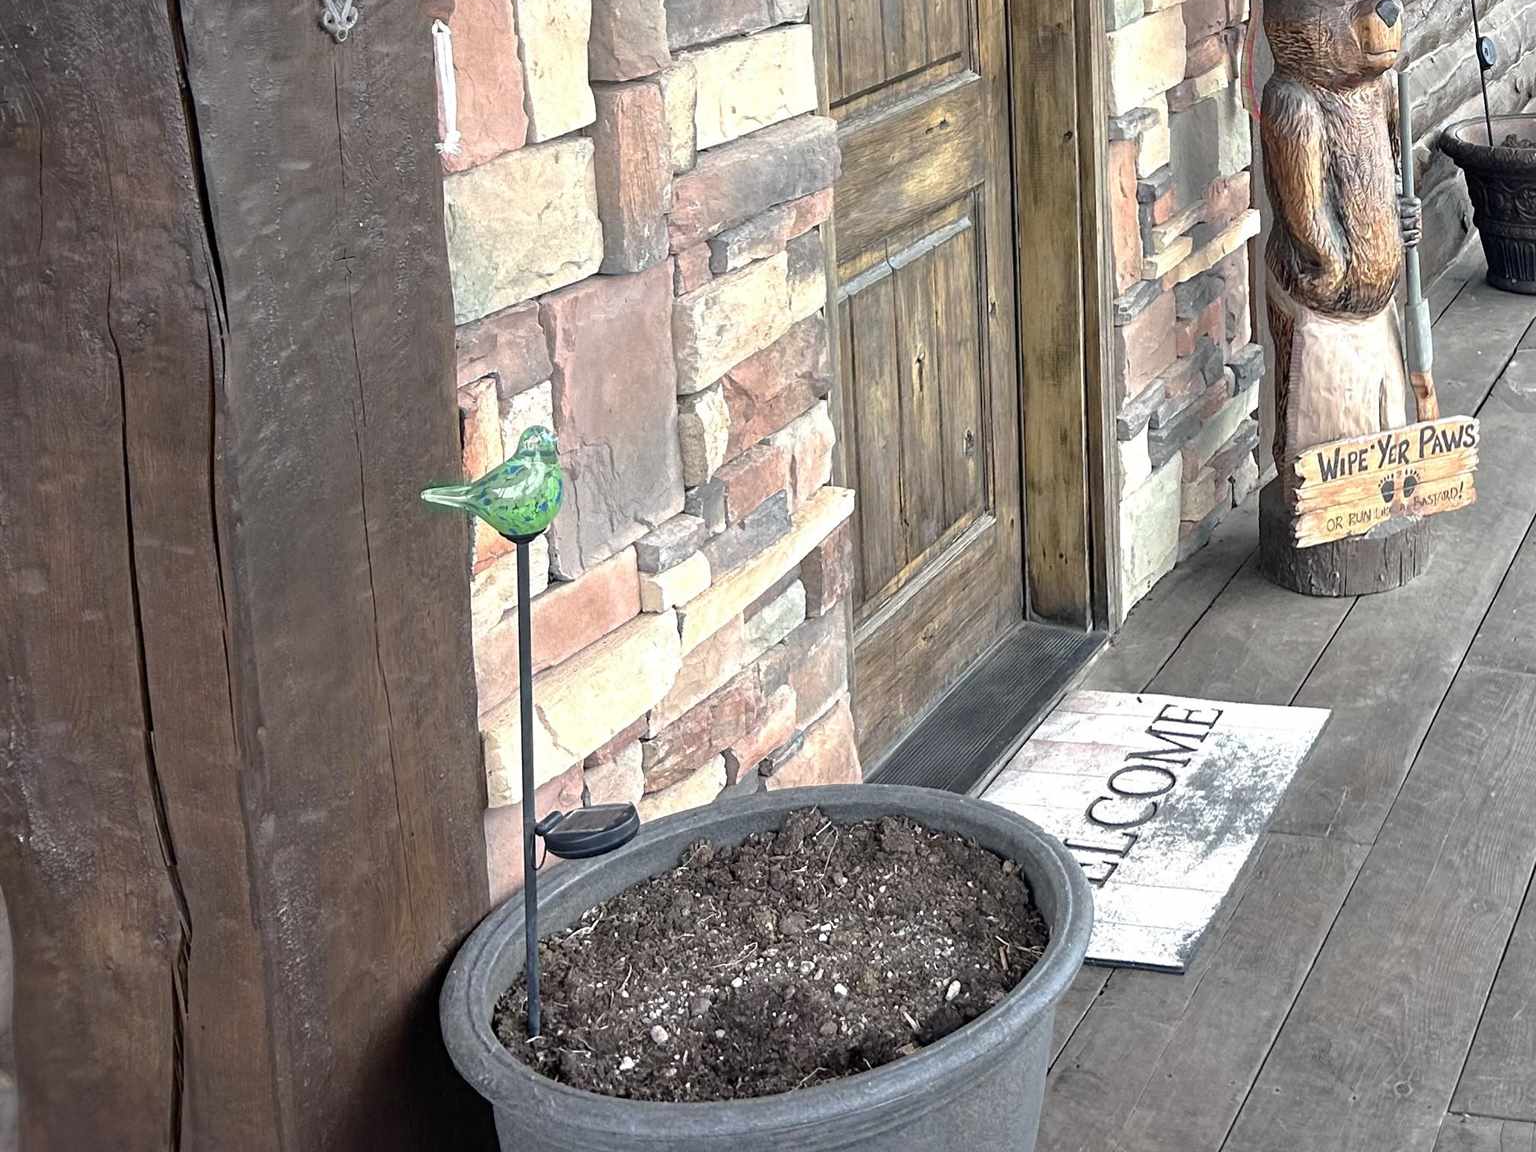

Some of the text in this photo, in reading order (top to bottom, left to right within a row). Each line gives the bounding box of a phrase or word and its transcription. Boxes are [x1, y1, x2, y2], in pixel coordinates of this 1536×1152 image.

[1419, 424, 1476, 459] PAWS
[1326, 517, 1344, 533] OR
[1348, 508, 1372, 526] RUN
[1374, 504, 1394, 520] LIK
[1063, 703, 1224, 889] ELCOME
